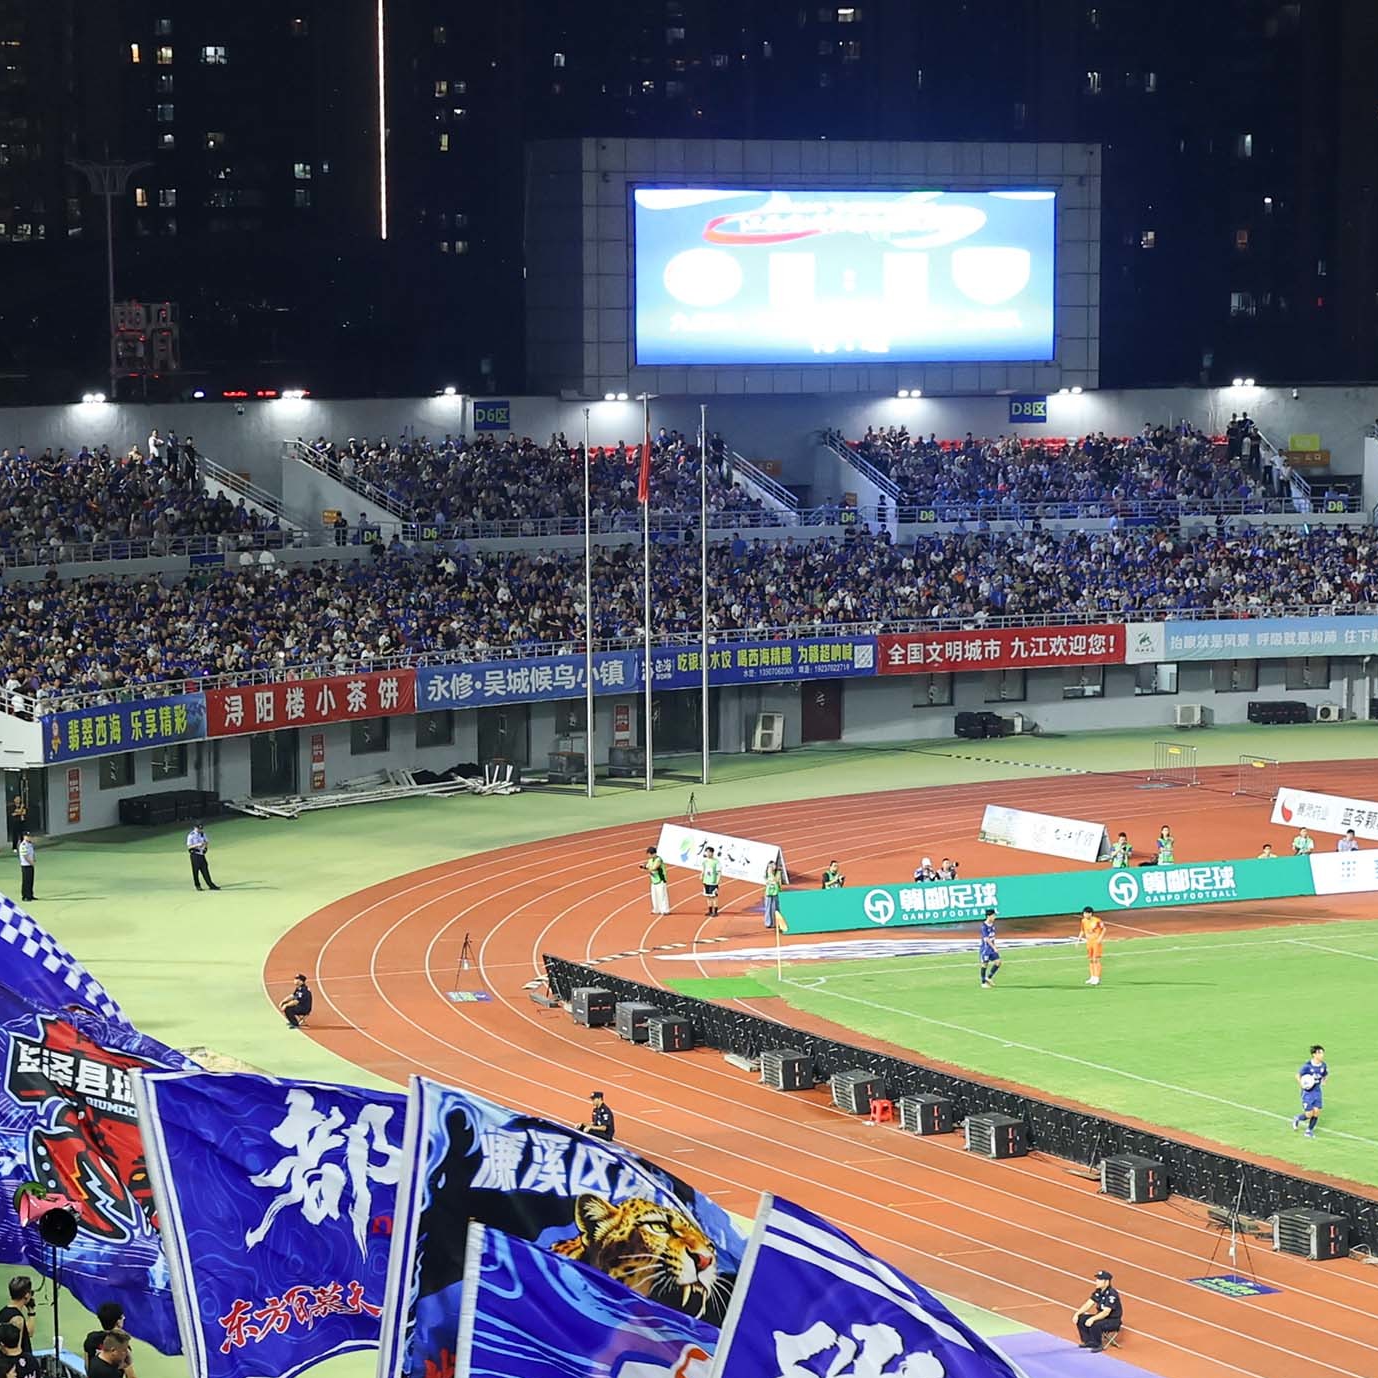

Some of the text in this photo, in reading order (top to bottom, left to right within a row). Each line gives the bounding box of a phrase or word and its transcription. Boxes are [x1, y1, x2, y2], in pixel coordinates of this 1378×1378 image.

[476, 408, 509, 423] D6区
[1012, 402, 1046, 416] D8区
[888, 634, 1116, 666] 全国文明城市 九江欢迎您！
[224, 677, 399, 728] 浔阳楼小茶饼
[131, 703, 188, 741] 乐享精彩
[1142, 866, 1236, 893] 赣鄱足球
[899, 883, 998, 912] 赣鄱足球
[1145, 890, 1238, 903] GANPO FOOTBALL
[902, 908, 1000, 921] GANPO FOOTBAL
